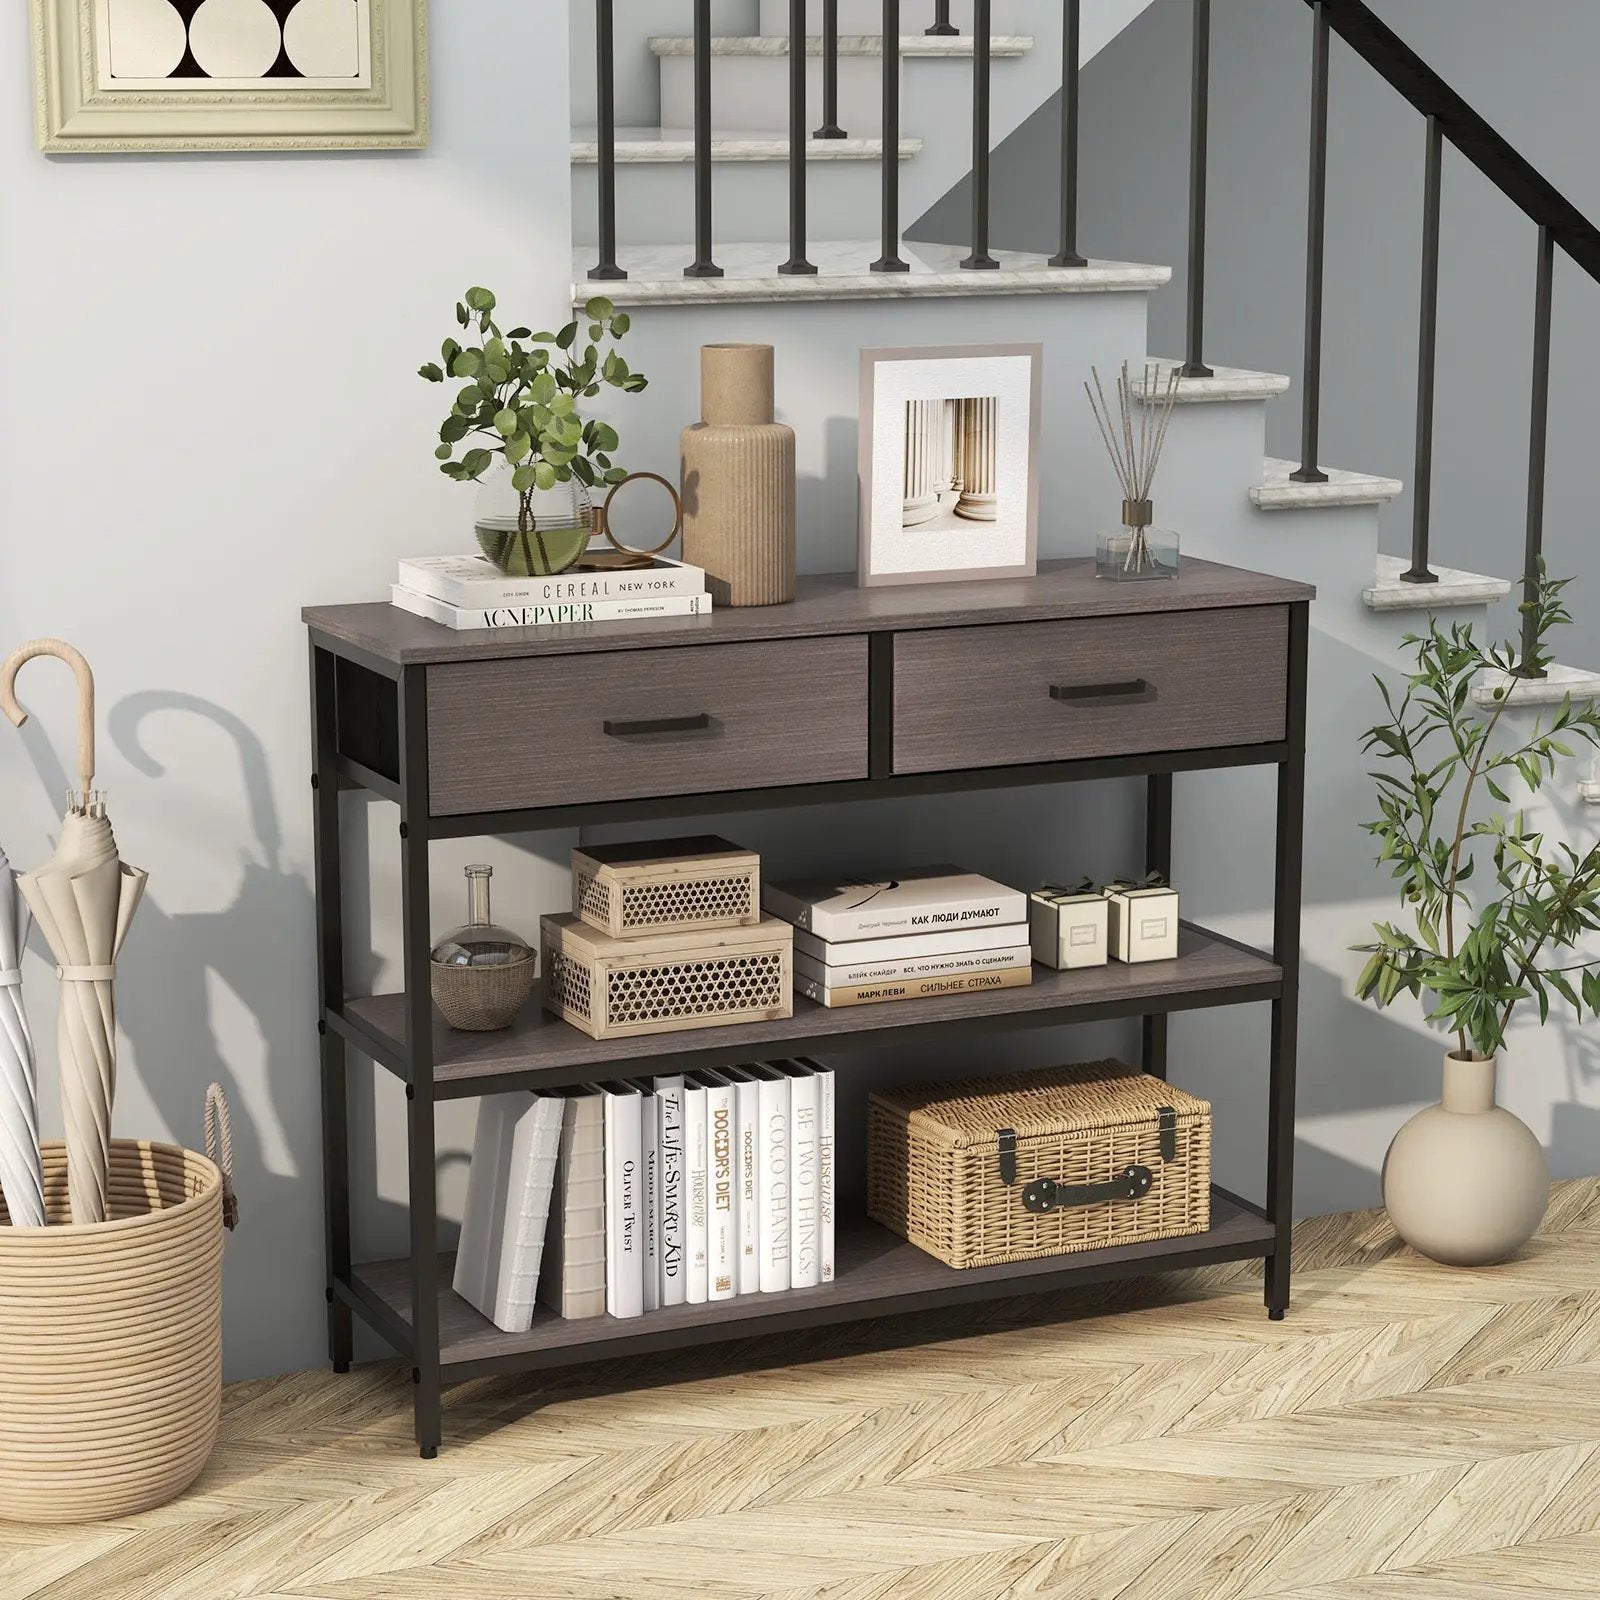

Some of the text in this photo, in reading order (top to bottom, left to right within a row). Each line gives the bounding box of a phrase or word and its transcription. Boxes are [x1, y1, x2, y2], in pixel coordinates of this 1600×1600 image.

[543, 580, 676, 599] CEREAL NEW YORK
[481, 603, 594, 627] ACNEPAPER
[911, 907, 1000, 925] КАК ЛЮДИ ДУМАЮТ
[848, 968, 897, 980] БЛЕЙК СНАЙДЕР
[917, 964, 930, 972] ЧТО
[930, 962, 954, 971] НУЖНО
[955, 960, 974, 968] ЗНАТЬ
[981, 955, 1015, 965] СЦЕНАРИИ
[857, 987, 906, 1000] МАРК ЛЕВИ
[920, 976, 1002, 994] СИЛЬНЕЕ СТРАХА
[664, 1092, 680, 1124] The
[744, 1179, 753, 1201] DIET
[797, 1106, 816, 1276] BE TWO THINGS:
[818, 1135, 834, 1225] Housewise
[622, 1160, 636, 1253] OLIVER TWIST
[647, 1150, 656, 1258] MIDDLEMARCH
[691, 1169, 706, 1228] Housewise
[715, 1181, 730, 1212] DIET
[770, 1182, 789, 1268] CHANEL
